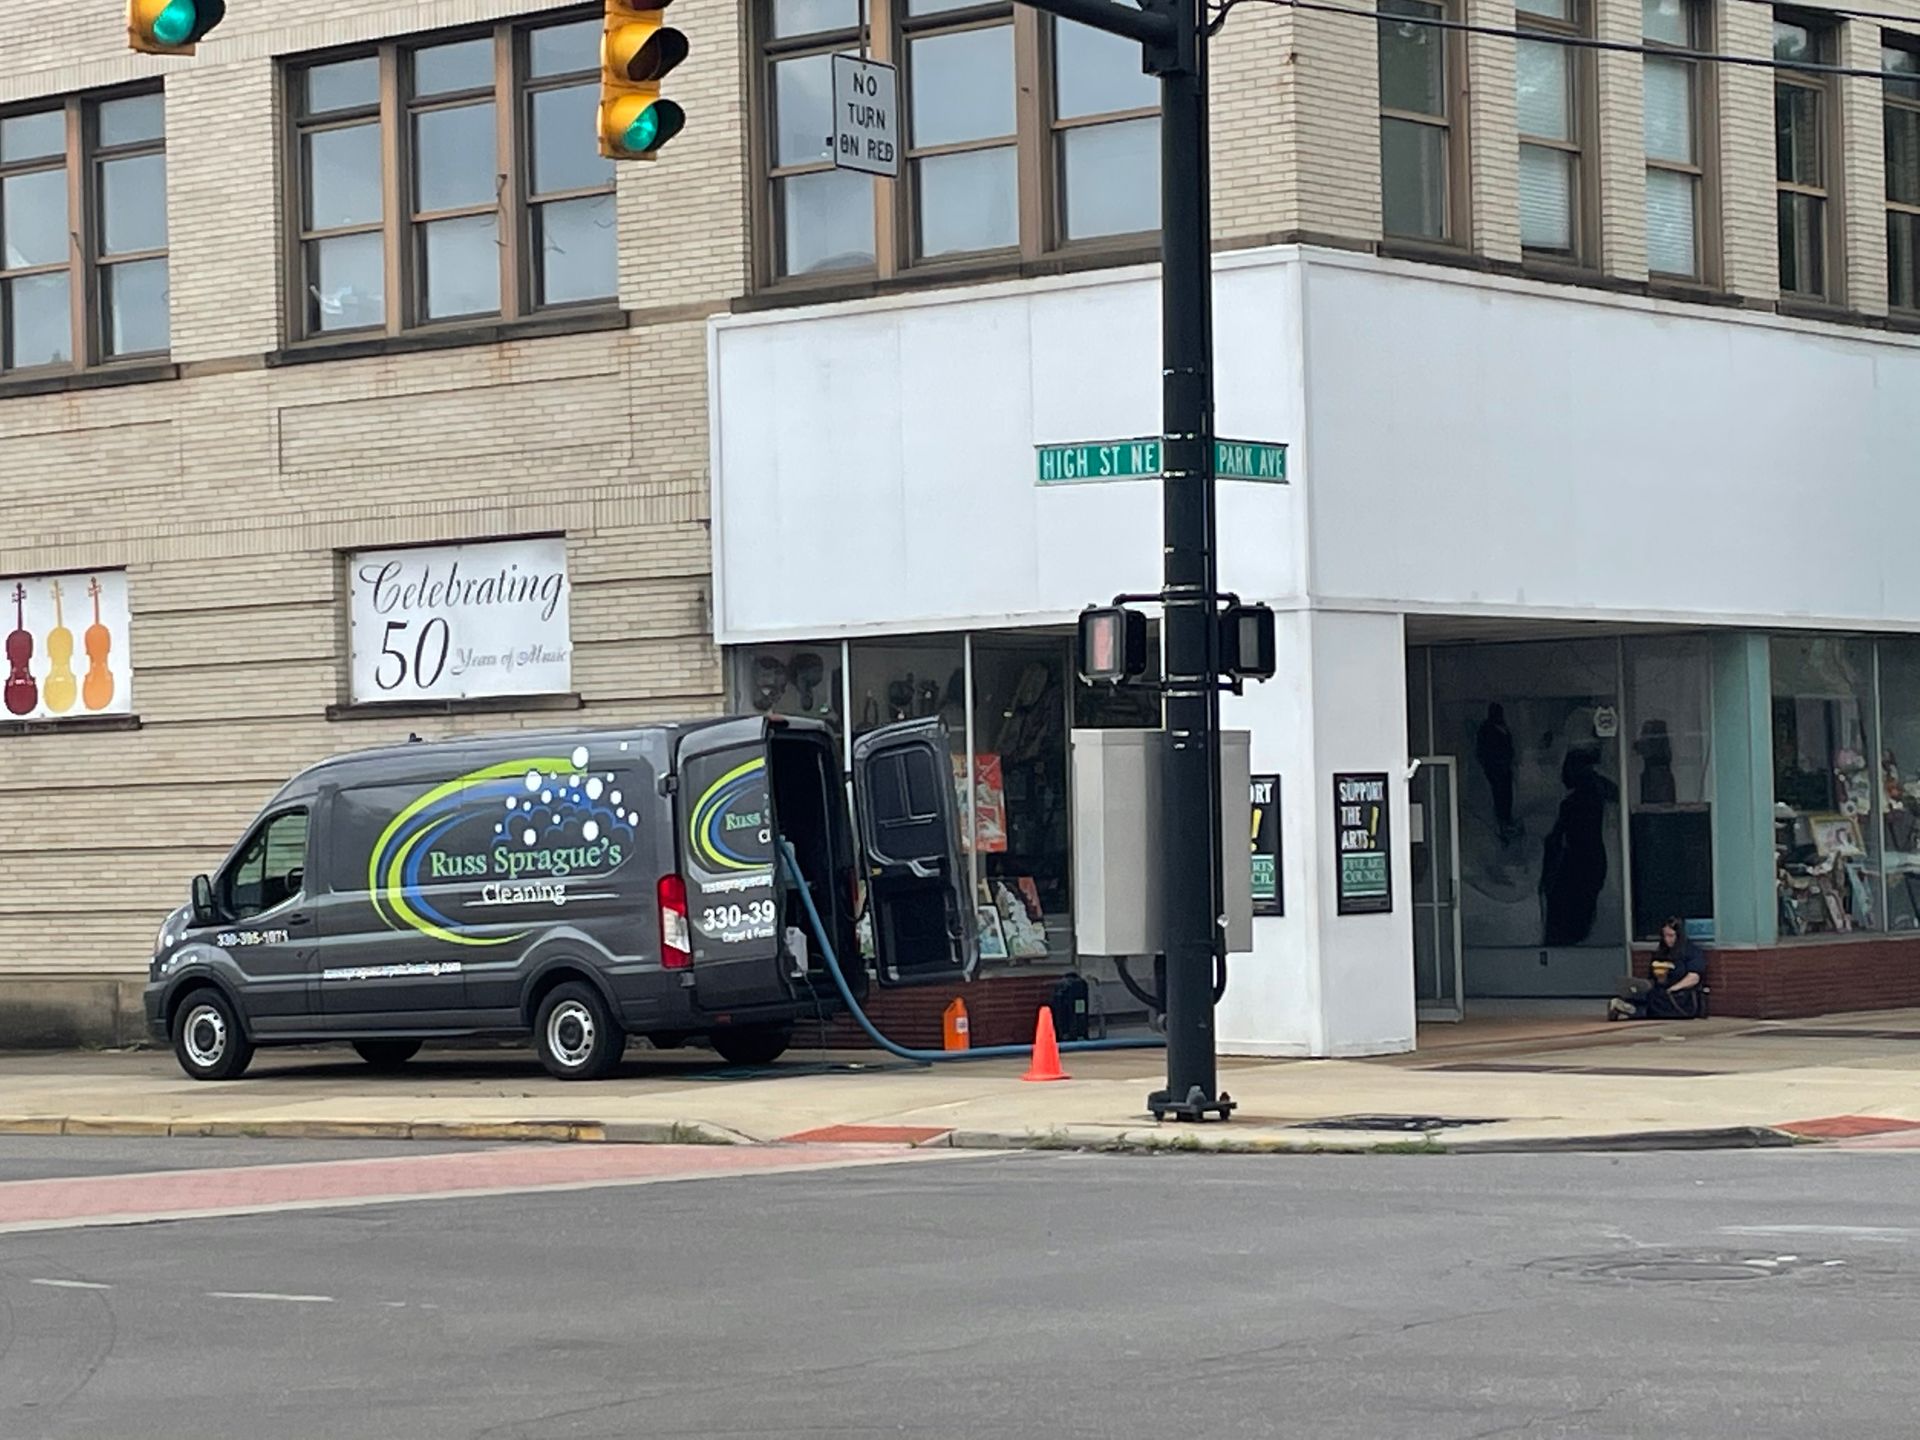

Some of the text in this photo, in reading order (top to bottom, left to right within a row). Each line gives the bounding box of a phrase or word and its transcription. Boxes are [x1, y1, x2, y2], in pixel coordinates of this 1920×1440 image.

[853, 72, 877, 96] NO
[847, 103, 885, 130] TURN
[840, 134, 894, 162] ON RED
[1042, 443, 1155, 479] HIGH ST NE
[1218, 447, 1283, 477] PARK AVE
[359, 560, 563, 621] Celebrating
[375, 617, 450, 690] 50
[501, 647, 515, 673] of
[1338, 781, 1384, 803] SUPPORT
[725, 812, 761, 830] Russ
[1340, 806, 1362, 826] THE
[1341, 830, 1369, 850] ARTS
[430, 837, 622, 878] Russ Sprague's
[482, 881, 567, 905] Cleaning
[703, 899, 776, 931] 330-39
